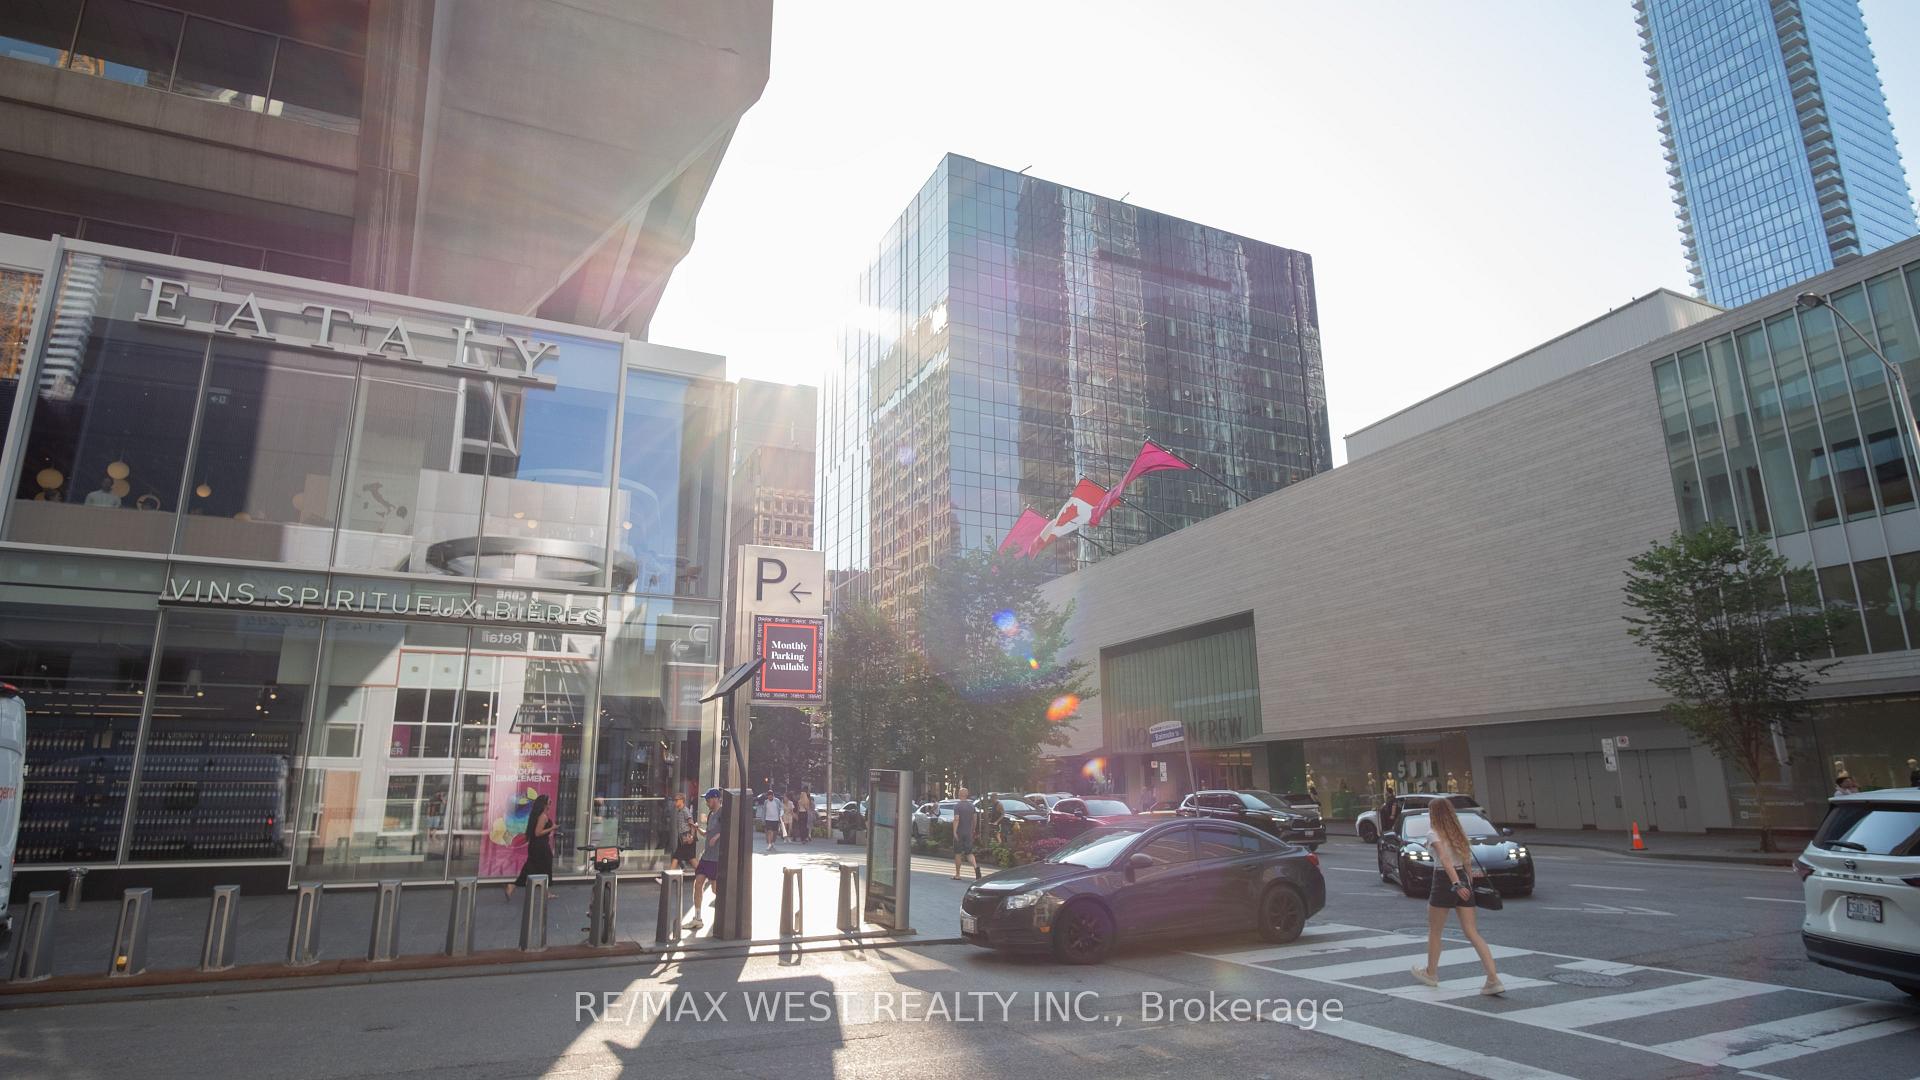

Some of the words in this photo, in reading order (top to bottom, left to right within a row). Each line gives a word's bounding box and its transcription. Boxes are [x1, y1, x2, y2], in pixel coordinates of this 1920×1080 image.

[134, 274, 558, 382] EATALY
[756, 557, 788, 601] P
[169, 578, 256, 606] VINS
[276, 585, 480, 618] SPIRITUEUX
[494, 597, 603, 626] BIÈRES
[771, 640, 809, 652] Monthly
[771, 651, 805, 663] Parking
[770, 662, 809, 671] Available
[1826, 872, 1884, 882] SIENNA
